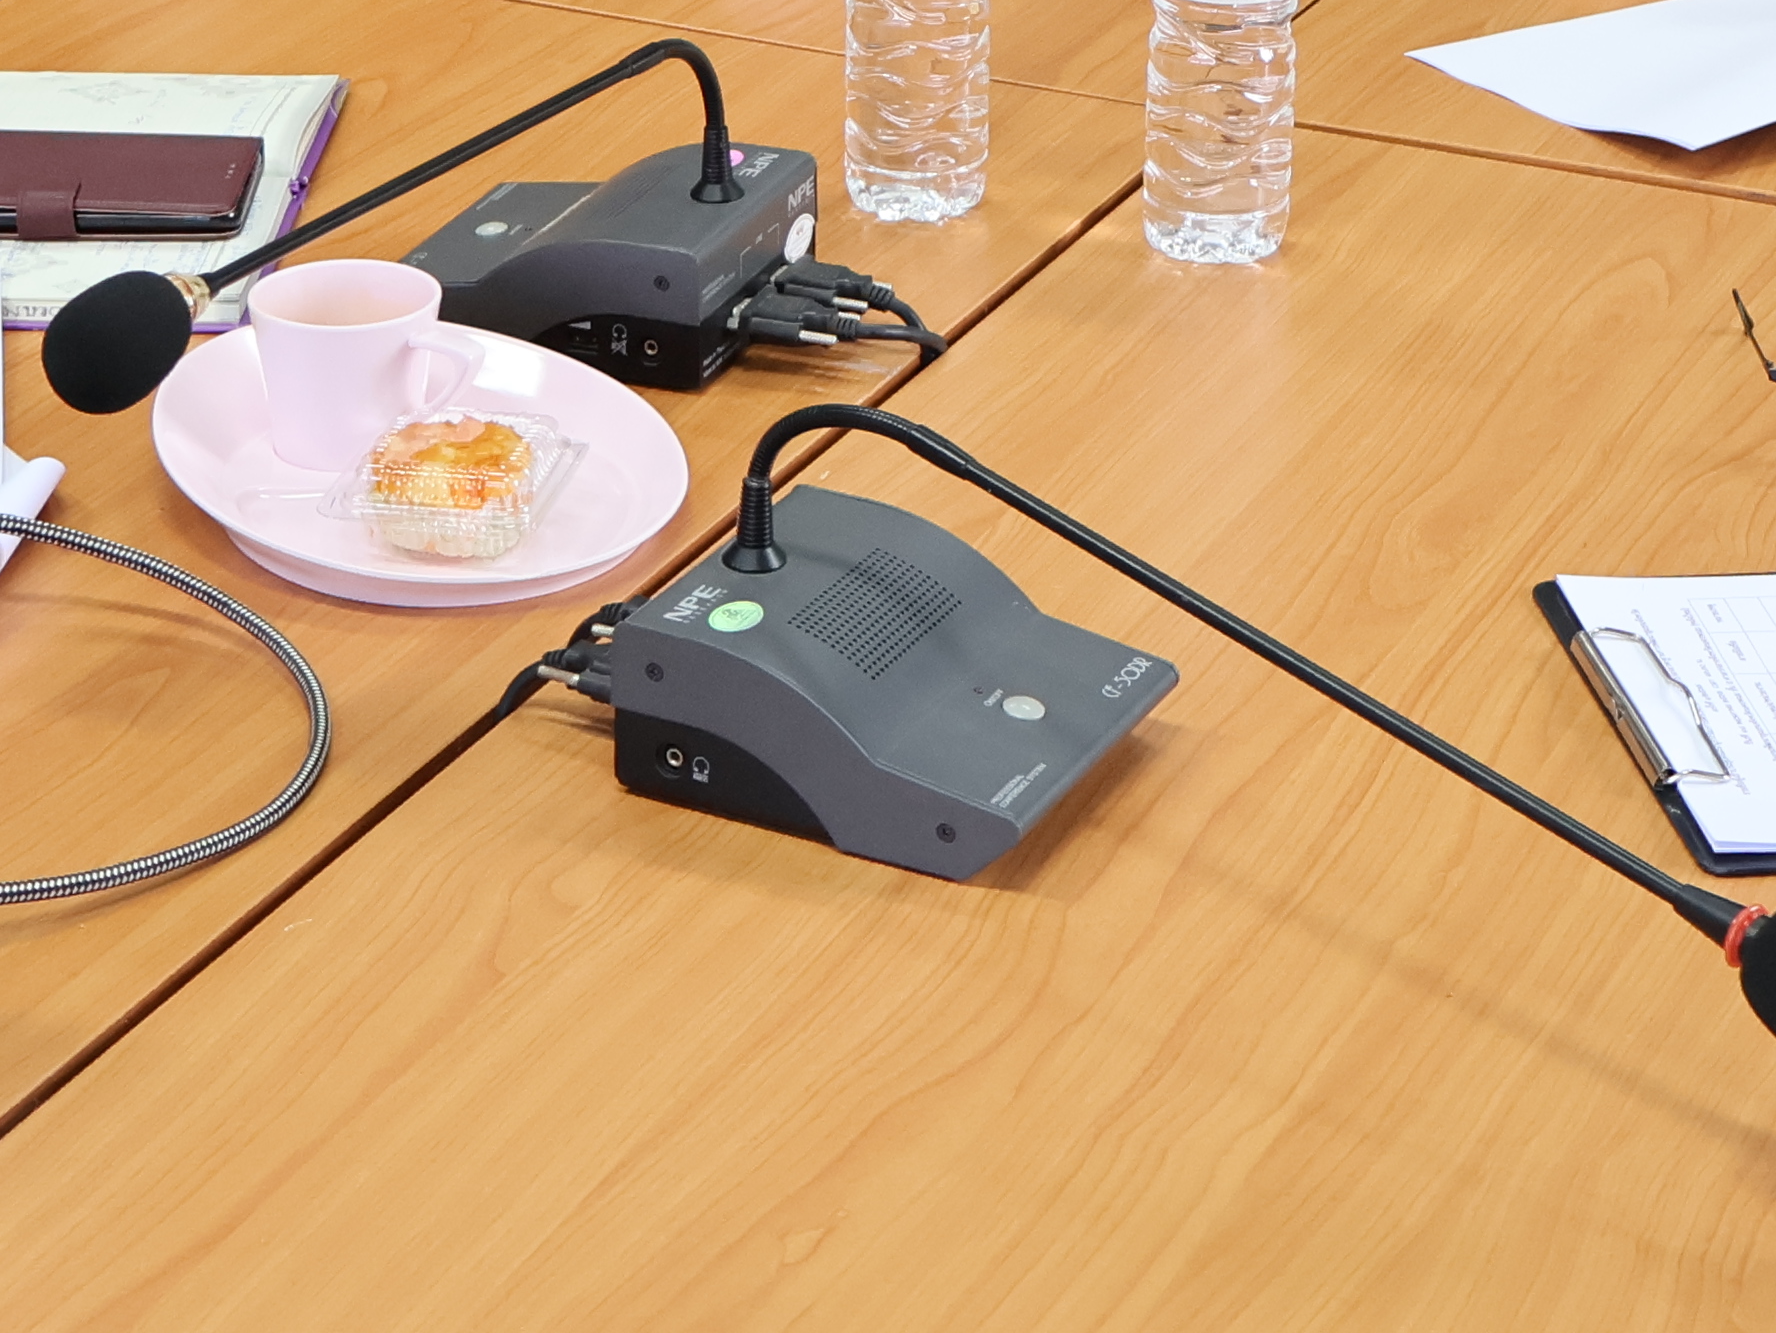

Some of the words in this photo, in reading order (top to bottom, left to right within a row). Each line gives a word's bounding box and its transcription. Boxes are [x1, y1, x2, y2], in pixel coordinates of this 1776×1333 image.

[738, 152, 780, 178] NPE
[788, 175, 815, 211] NPE
[663, 585, 721, 622] NPE
